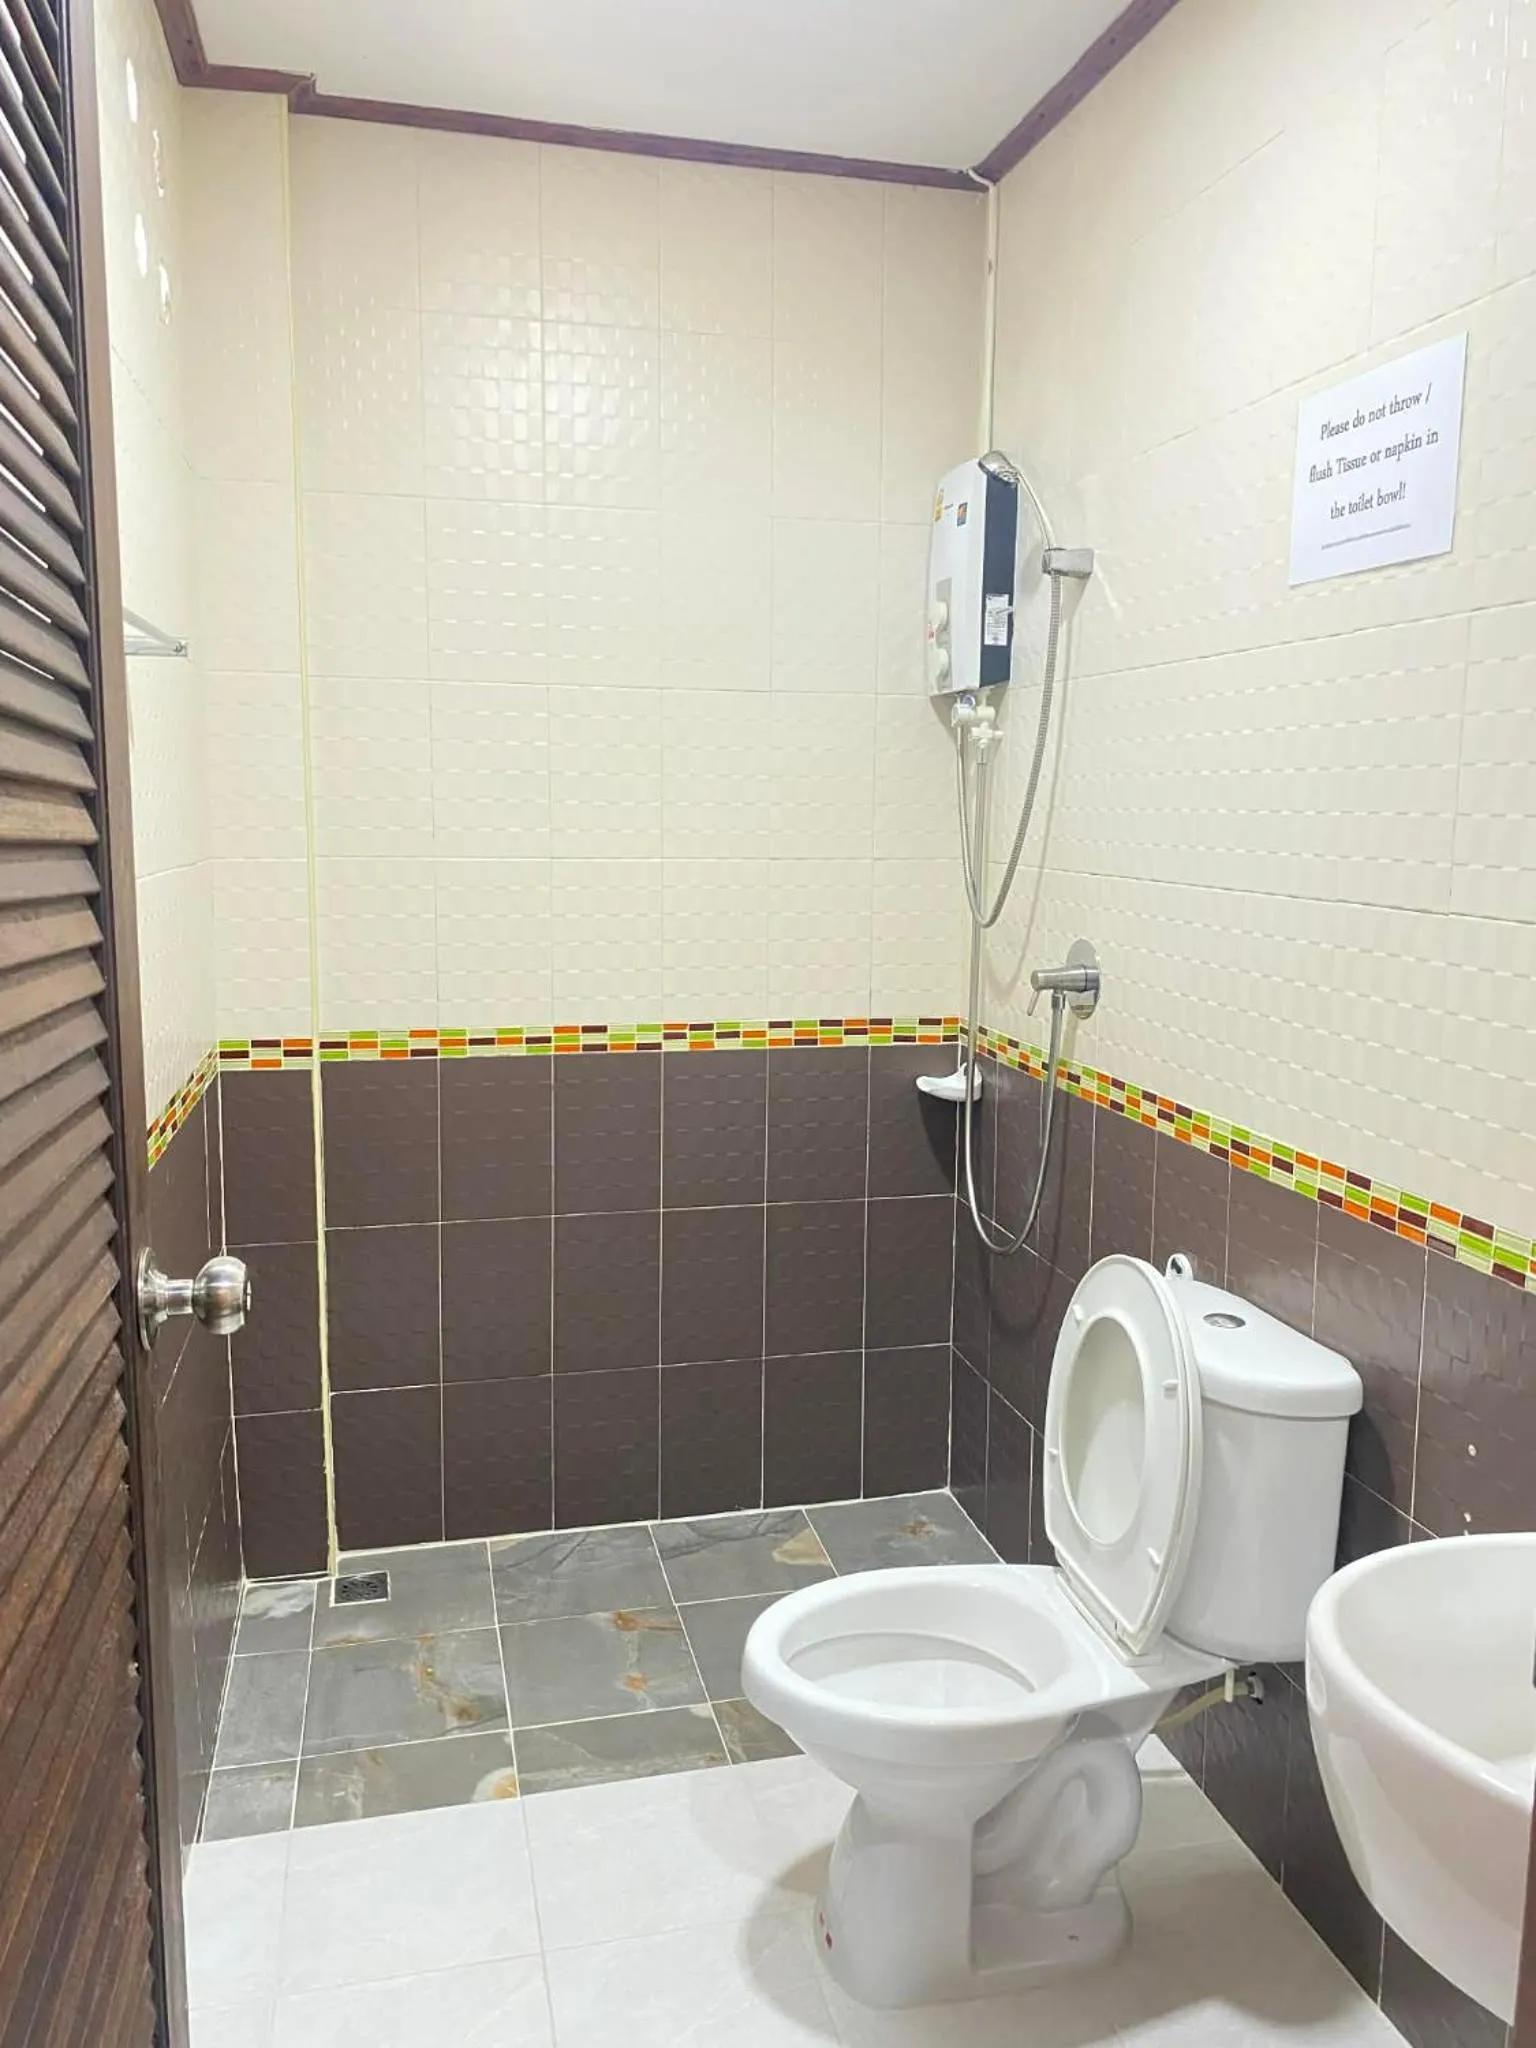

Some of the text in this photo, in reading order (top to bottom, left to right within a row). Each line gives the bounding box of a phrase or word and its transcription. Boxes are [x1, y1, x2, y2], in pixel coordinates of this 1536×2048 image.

[1320, 419, 1349, 441] Please
[1353, 409, 1365, 429] do
[1368, 404, 1386, 423] not
[1389, 393, 1422, 413] throw
[1309, 429, 1439, 483] flush Tissue or napkin in
[1330, 482, 1407, 519] the toilet bowl!
